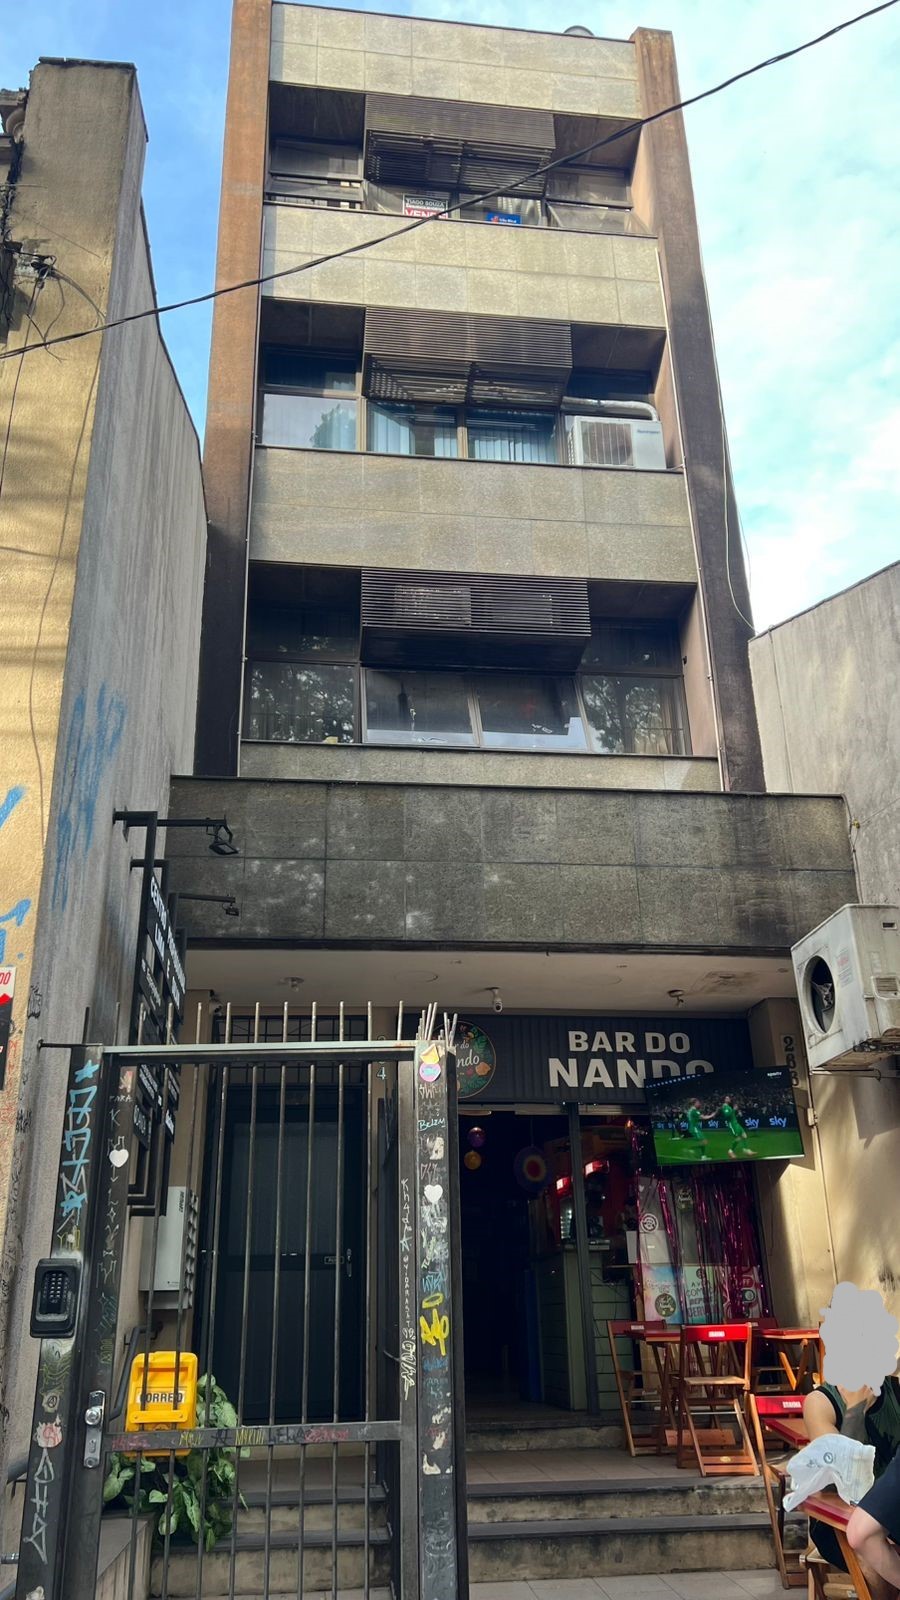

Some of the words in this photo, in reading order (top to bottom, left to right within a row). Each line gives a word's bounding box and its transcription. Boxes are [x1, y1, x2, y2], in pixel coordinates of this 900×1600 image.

[461, 1040, 469, 1049] do
[568, 1030, 636, 1053] BAR
[645, 1032, 691, 1054] DO
[456, 1049, 480, 1068] ndo
[745, 1117, 760, 1128] sky
[769, 1115, 787, 1127] sky
[140, 1391, 183, 1404] ORREO
